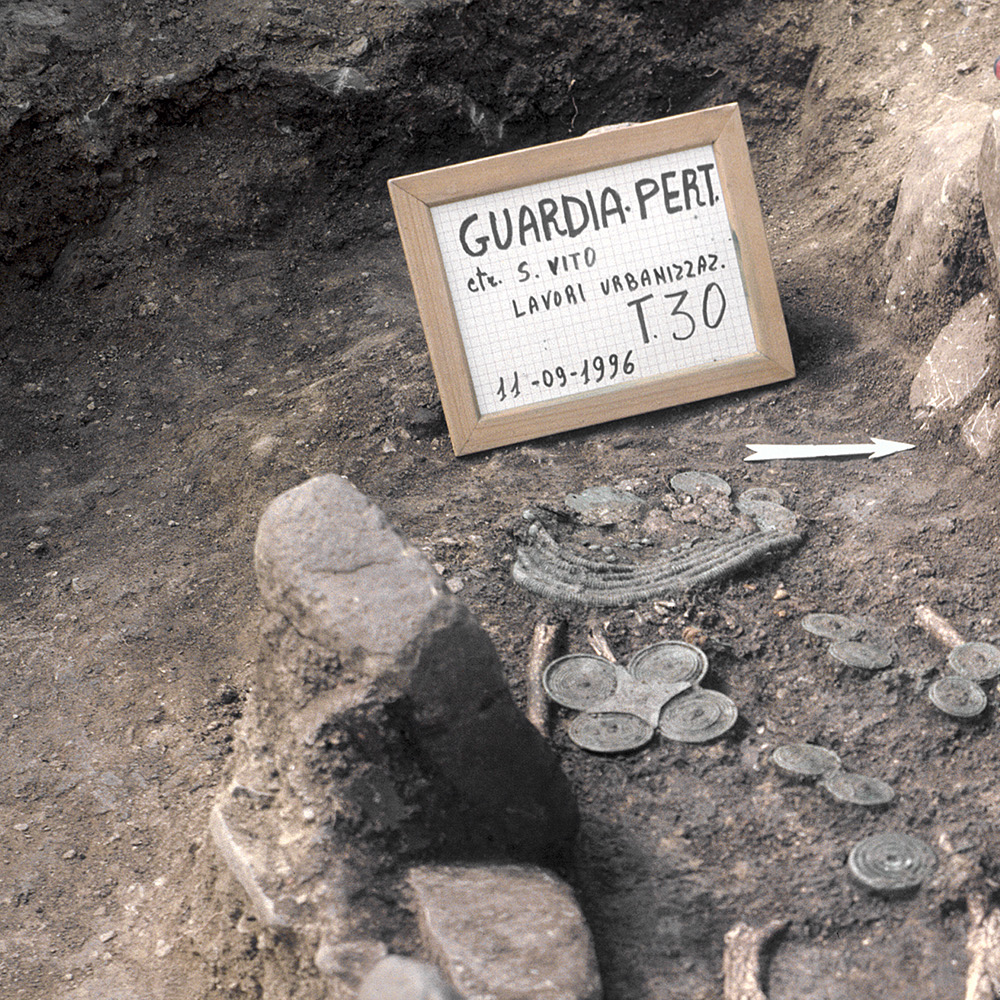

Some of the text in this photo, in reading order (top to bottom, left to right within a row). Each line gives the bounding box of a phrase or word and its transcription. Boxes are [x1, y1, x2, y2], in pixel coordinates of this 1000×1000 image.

[511, 254, 726, 318] LAVORI URBANIZZAZ.
[517, 261, 540, 282] S.
[547, 247, 597, 275] VITO
